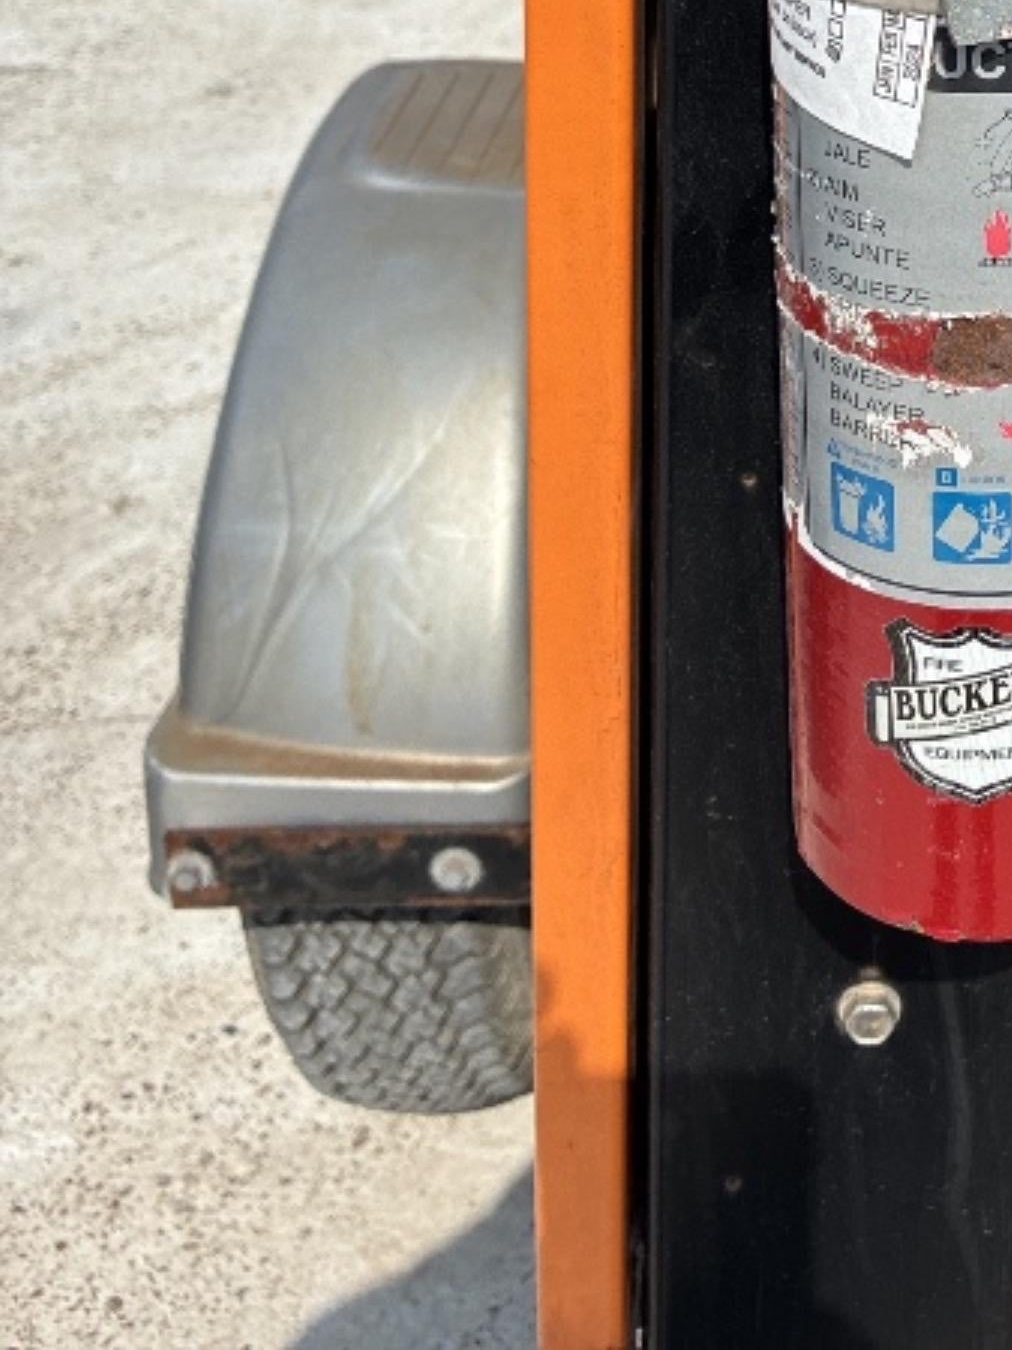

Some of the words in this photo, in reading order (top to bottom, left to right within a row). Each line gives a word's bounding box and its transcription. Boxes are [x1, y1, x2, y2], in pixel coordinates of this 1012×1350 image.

[824, 231, 911, 271] APUNTE
[828, 266, 931, 309] SQUEEZE
[830, 381, 925, 422] BALAYER
